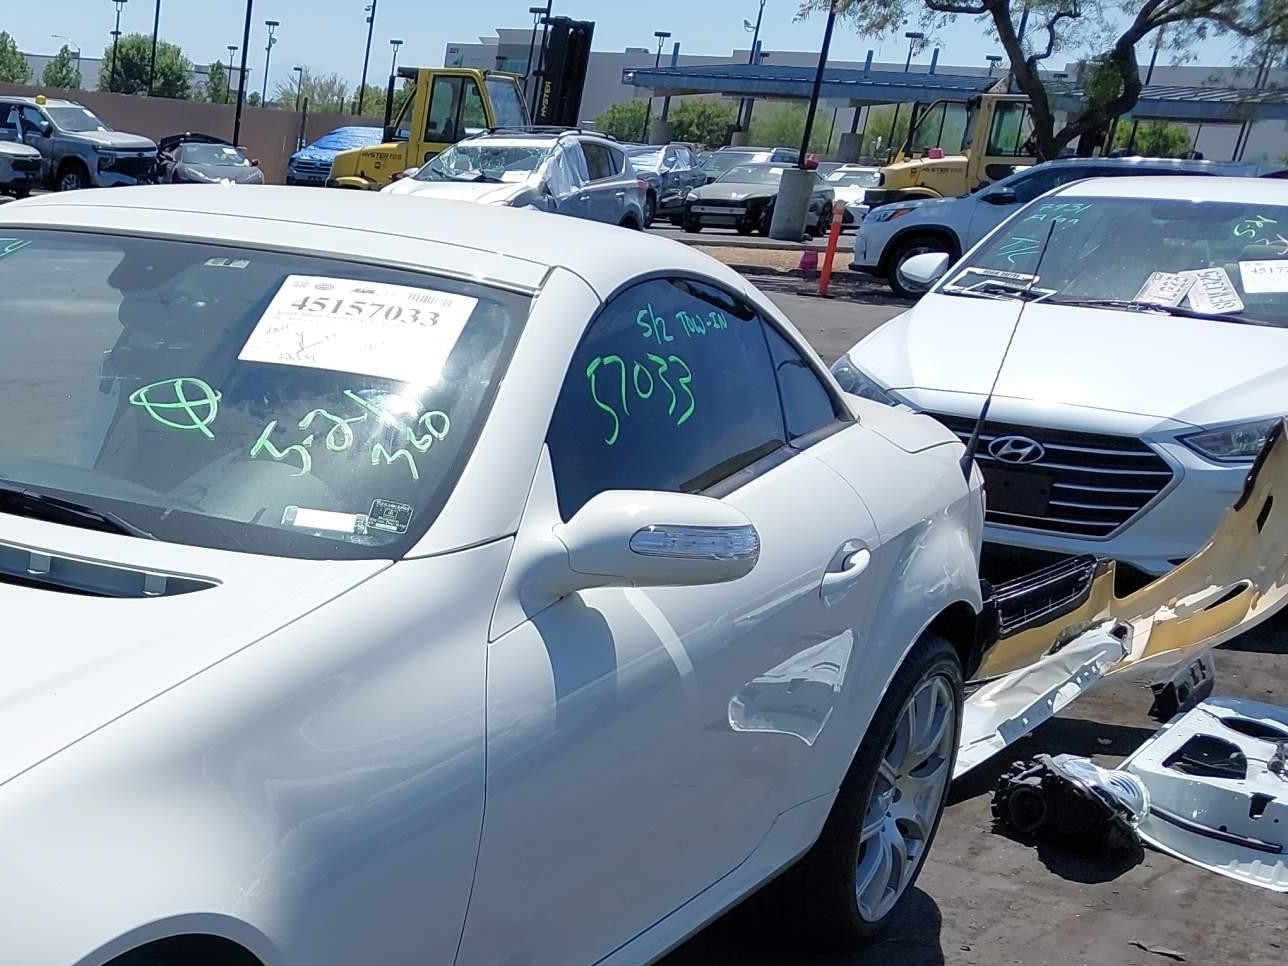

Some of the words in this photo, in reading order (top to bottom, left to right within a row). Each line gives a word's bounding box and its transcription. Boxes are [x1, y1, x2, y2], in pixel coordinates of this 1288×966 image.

[540, 80, 552, 118] HYSTER
[361, 151, 390, 160] HYSTER
[291, 296, 441, 327] 45157033
[586, 353, 696, 446] 57033
